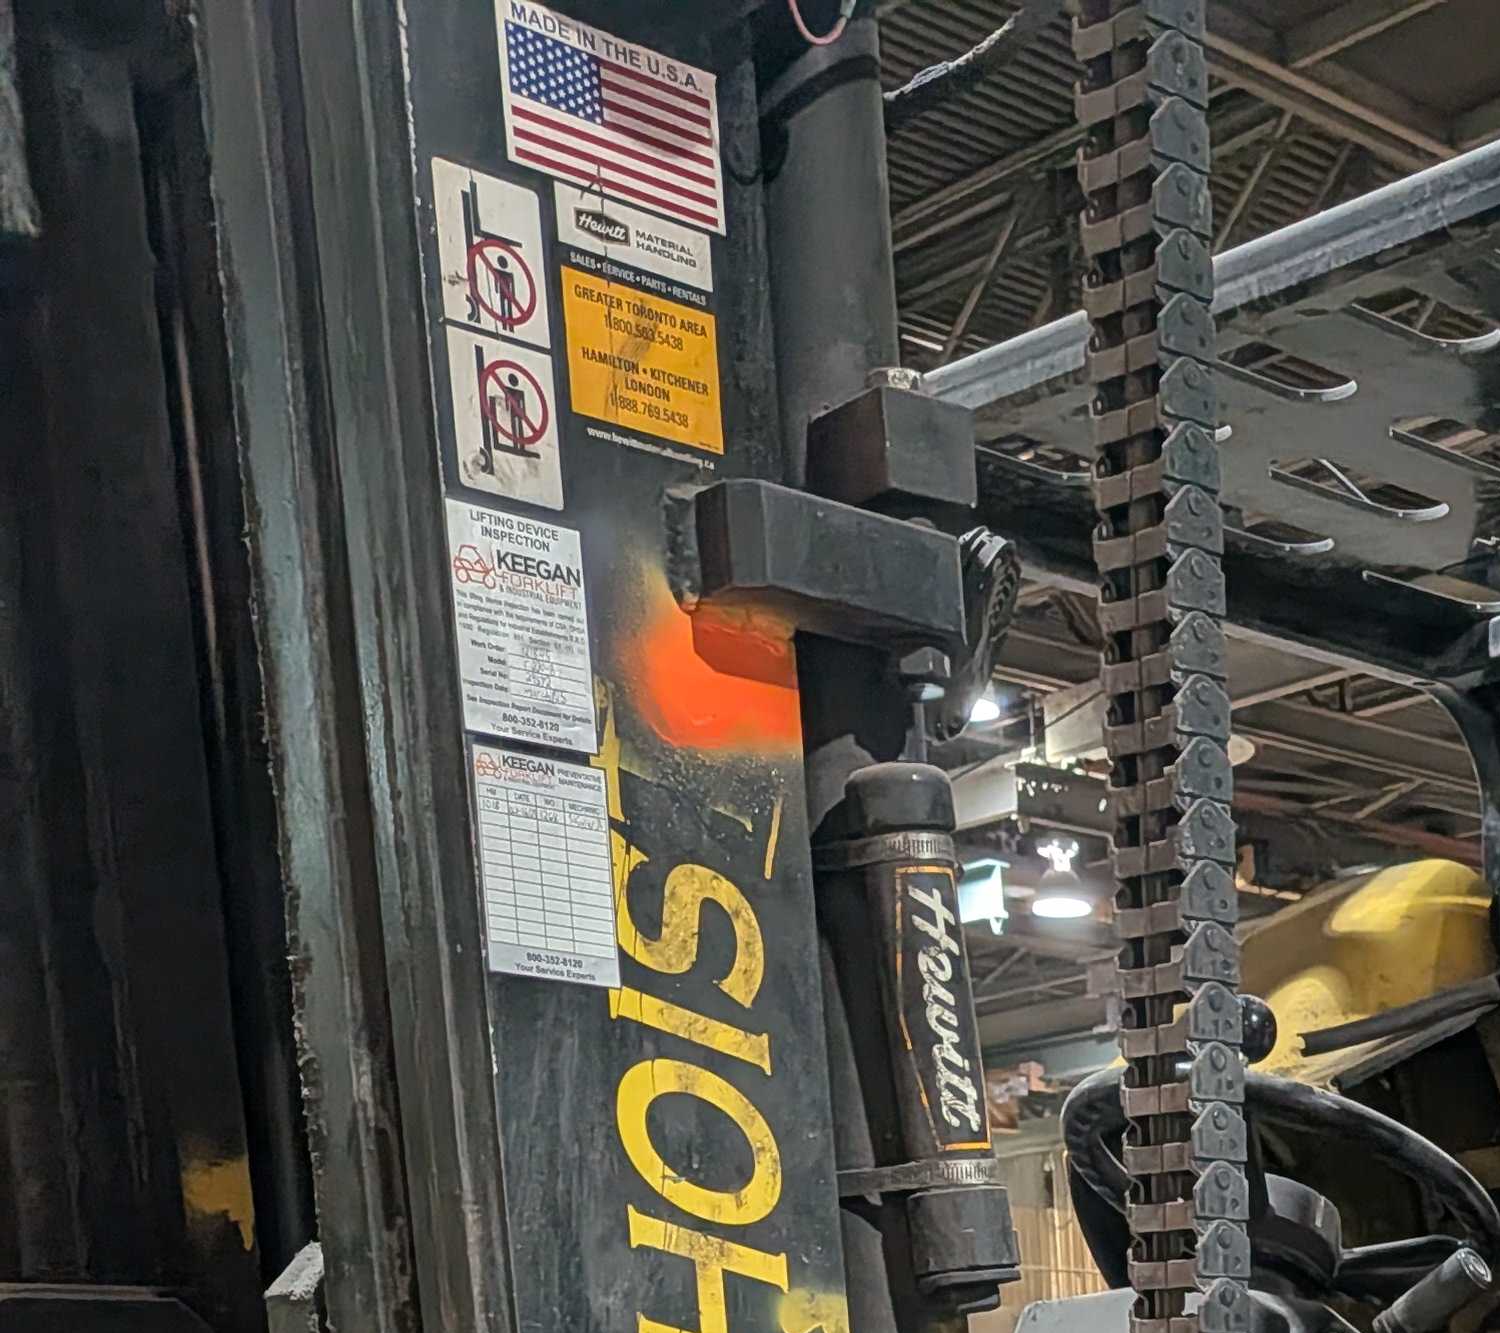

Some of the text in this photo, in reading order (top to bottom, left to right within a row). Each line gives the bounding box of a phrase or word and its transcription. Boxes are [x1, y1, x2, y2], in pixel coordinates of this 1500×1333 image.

[511, 1, 703, 93] MADE IN THE U.S.A.
[578, 212, 626, 240] Hewitt
[636, 230, 693, 256] MATERIAL
[636, 240, 697, 268] HANDLING
[570, 252, 595, 269] SALES
[641, 275, 666, 293] PARTS
[673, 286, 706, 306] RENTALS
[574, 284, 707, 337] GREATER TORONTO AREA
[581, 347, 708, 396] HAMILTON KITCHENER
[624, 377, 671, 402] LONDON
[610, 393, 688, 428] 1888.769.5438
[470, 509, 559, 541] LIFTING DEVICE
[481, 526, 550, 552] INSPECTION
[496, 549, 581, 588] KEEGAN
[500, 572, 577, 601] FORKLIFT
[491, 723, 573, 746] Your Service Experts
[502, 713, 559, 732] 800-352-8120
[502, 755, 554, 776] KEEGAN
[515, 963, 596, 982] Your Service Experts
[526, 952, 583, 968] 800-352-8120
[908, 885, 981, 1132] Hewitt
